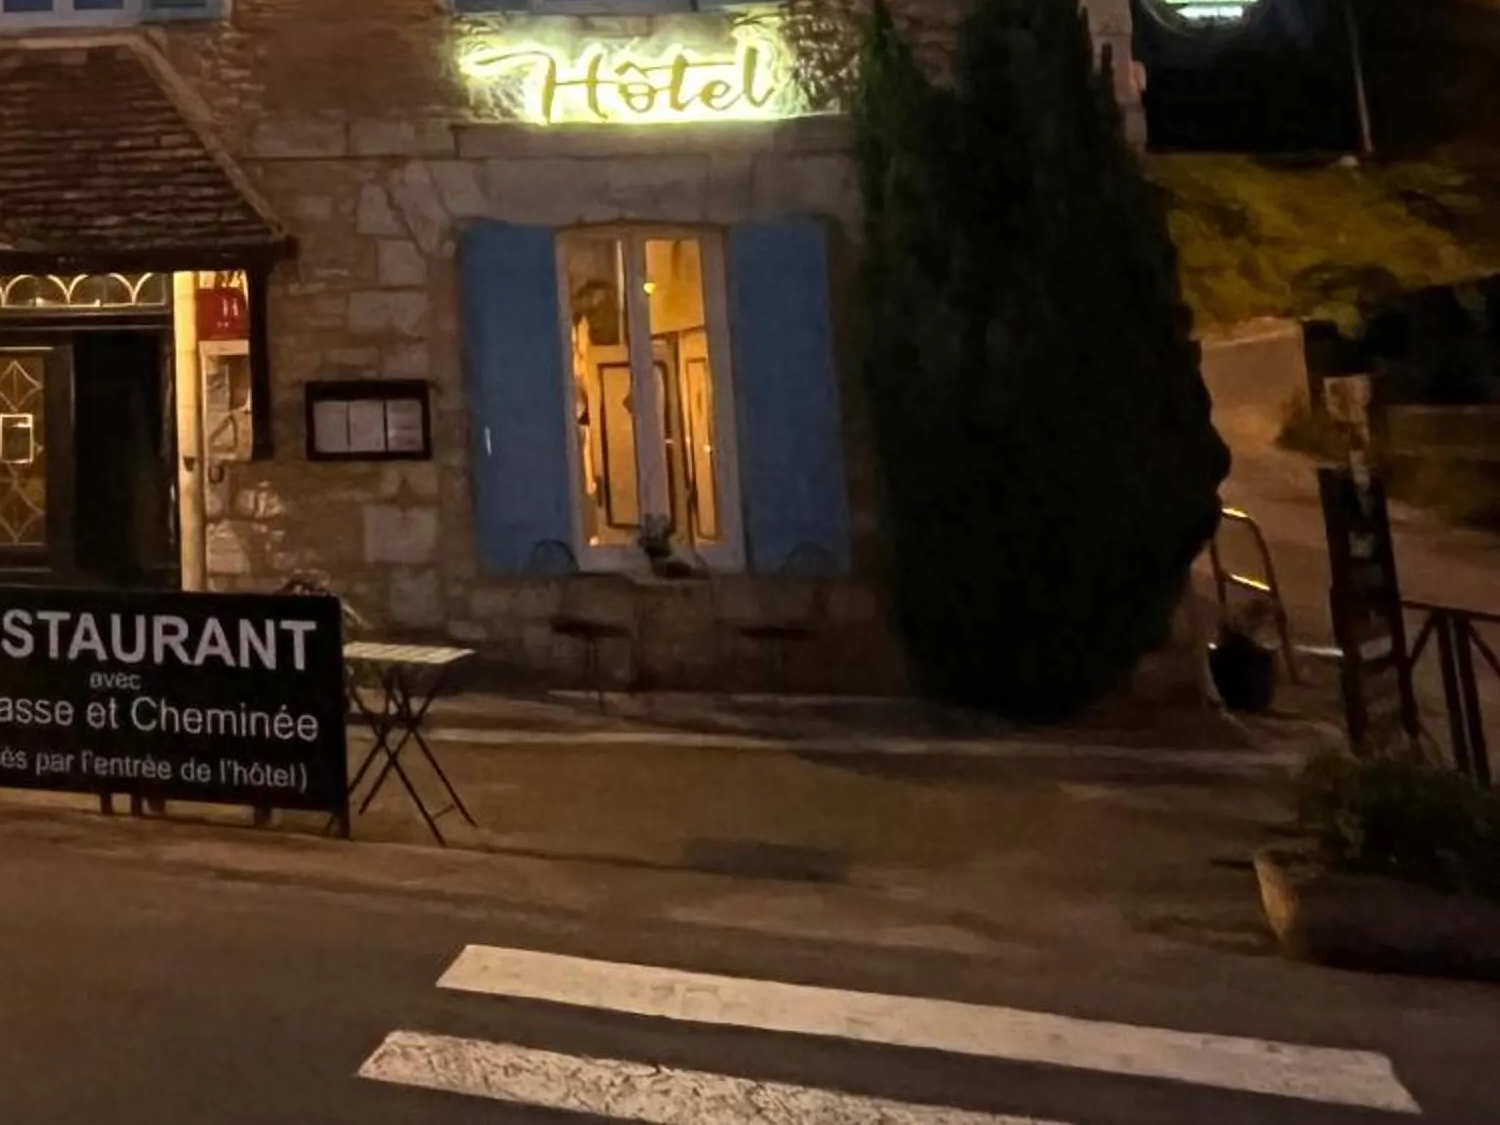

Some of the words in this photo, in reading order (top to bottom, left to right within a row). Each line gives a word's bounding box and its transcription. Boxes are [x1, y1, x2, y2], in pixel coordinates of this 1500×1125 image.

[476, 46, 775, 125] Hôtel
[90, 672, 142, 690] avec
[87, 697, 119, 729] et
[131, 696, 319, 742] Cheminée
[36, 750, 75, 775] par
[81, 751, 171, 780] l'entrée
[181, 757, 211, 782] de
[220, 759, 307, 794] l'hôtel)
